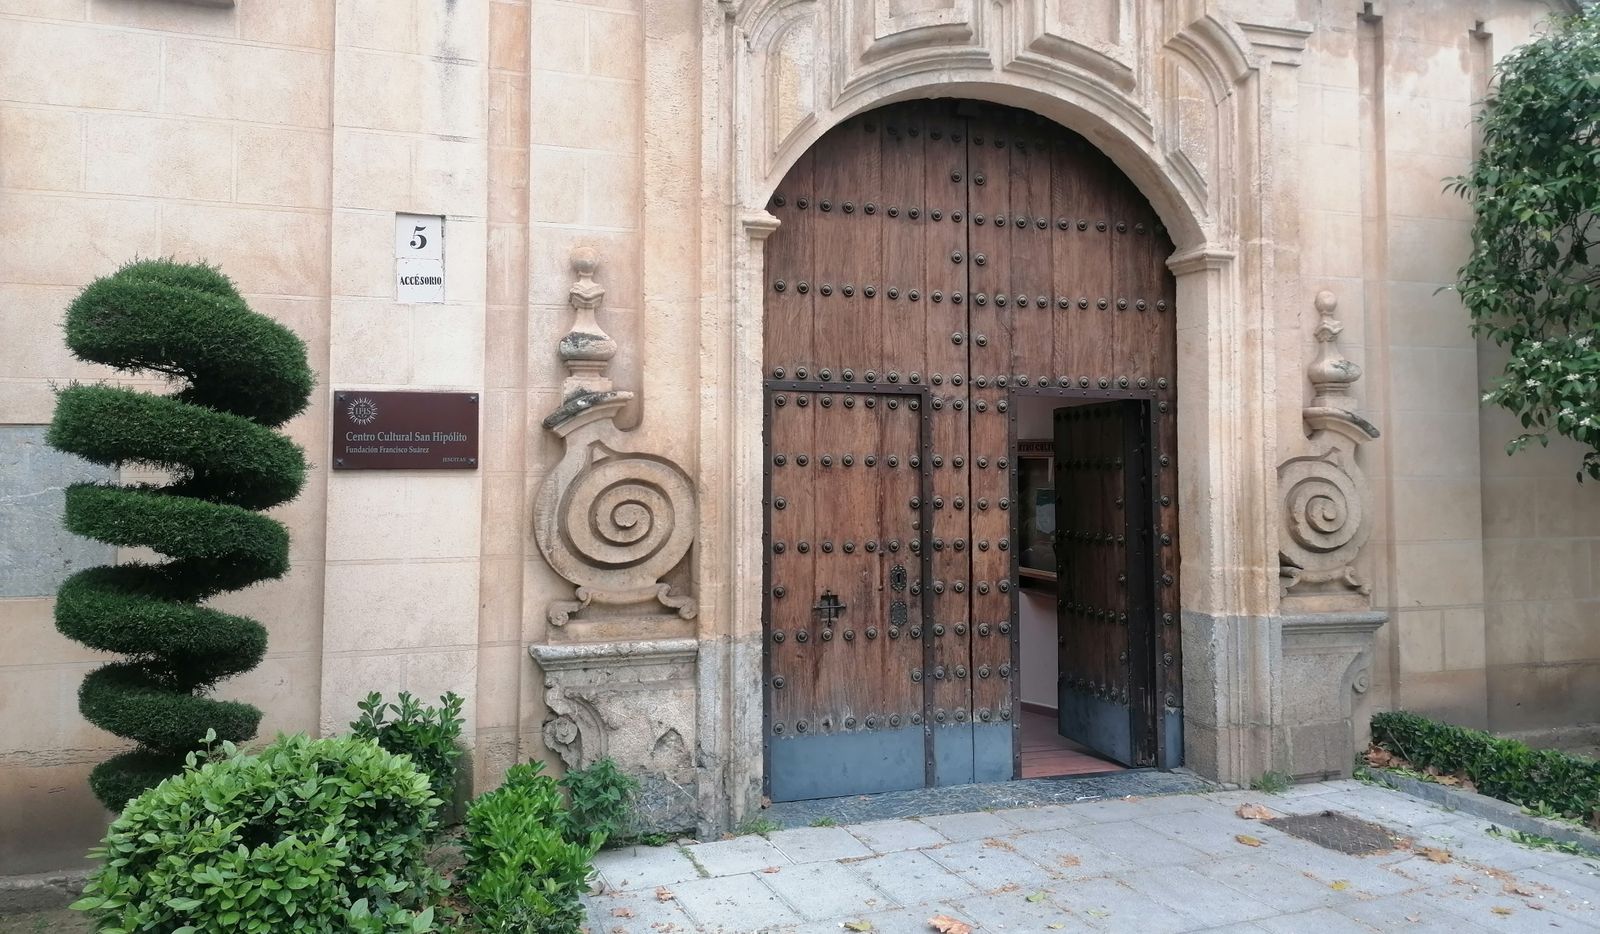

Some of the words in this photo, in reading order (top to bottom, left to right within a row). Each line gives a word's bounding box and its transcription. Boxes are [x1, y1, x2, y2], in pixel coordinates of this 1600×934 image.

[409, 226, 427, 249] 5
[345, 431, 376, 441] Centro
[377, 431, 413, 441] Cultural
[414, 431, 431, 441] San
[432, 431, 467, 444] Hipólito
[345, 445, 379, 453] Fundación
[379, 445, 408, 453] Francisco
[408, 445, 430, 453] Suárez
